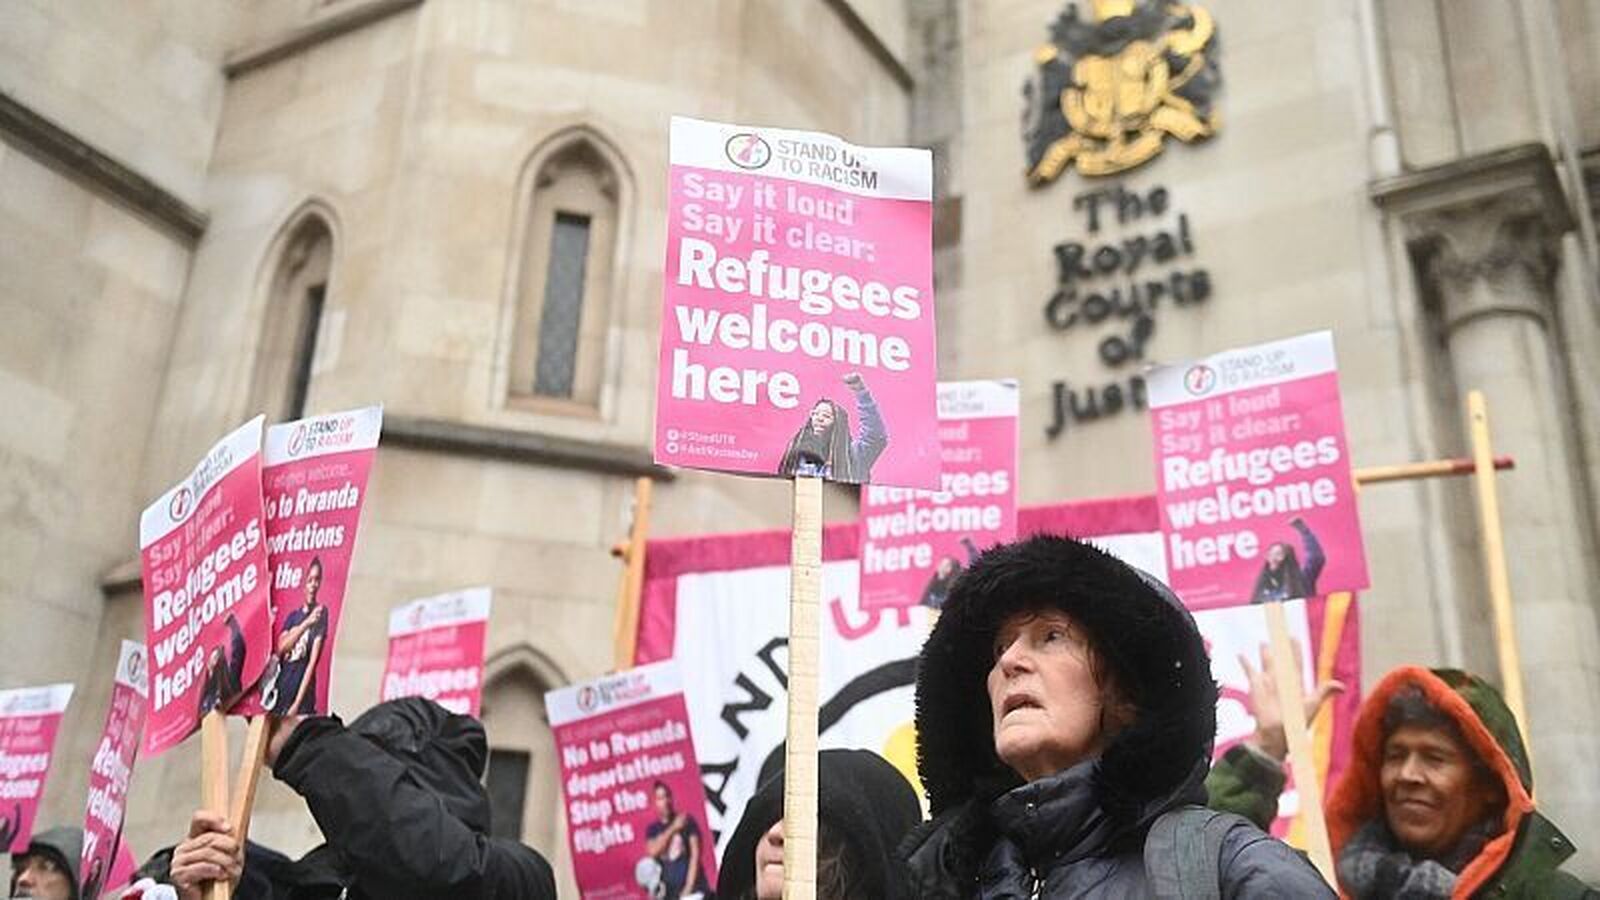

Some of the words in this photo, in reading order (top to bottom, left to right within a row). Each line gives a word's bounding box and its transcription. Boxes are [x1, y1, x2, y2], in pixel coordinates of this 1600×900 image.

[777, 140, 837, 163] STAND
[779, 156, 803, 175] TO
[808, 161, 878, 190] RACISM
[682, 173, 743, 211] Say
[753, 182, 777, 211] it
[787, 187, 856, 226] loud
[1073, 184, 1169, 233] The
[682, 203, 743, 244] Say
[753, 213, 777, 245] it
[786, 222, 875, 263] clear:
[1053, 212, 1194, 285] Royal
[676, 237, 922, 321] Refugees
[1044, 268, 1213, 330] Courts
[675, 304, 912, 372] welcome
[1098, 312, 1156, 367] of
[671, 349, 801, 409] here
[1161, 409, 1202, 431] Say
[1206, 401, 1223, 421] it
[1228, 387, 1280, 416] loud
[1162, 433, 1204, 454] Say
[1210, 425, 1227, 445] it
[1162, 436, 1340, 493] Refugees
[264, 496, 277, 519] o
[279, 493, 294, 518] to
[295, 481, 359, 516] Rwanda
[867, 504, 1002, 539] welcome
[1166, 477, 1337, 529] welcome
[150, 535, 181, 567] Say
[153, 517, 261, 632] Refugees
[864, 542, 933, 574] here
[1169, 530, 1260, 570] here
[152, 559, 184, 593] Say
[275, 562, 302, 591] the
[154, 562, 257, 669] welcome
[154, 646, 204, 712] here
[563, 743, 589, 769] No
[589, 739, 610, 762] to
[610, 719, 688, 756] Rwanda
[567, 751, 686, 798] deportations
[570, 800, 613, 827] Stop
[613, 788, 649, 814] the
[574, 821, 635, 855] flights
